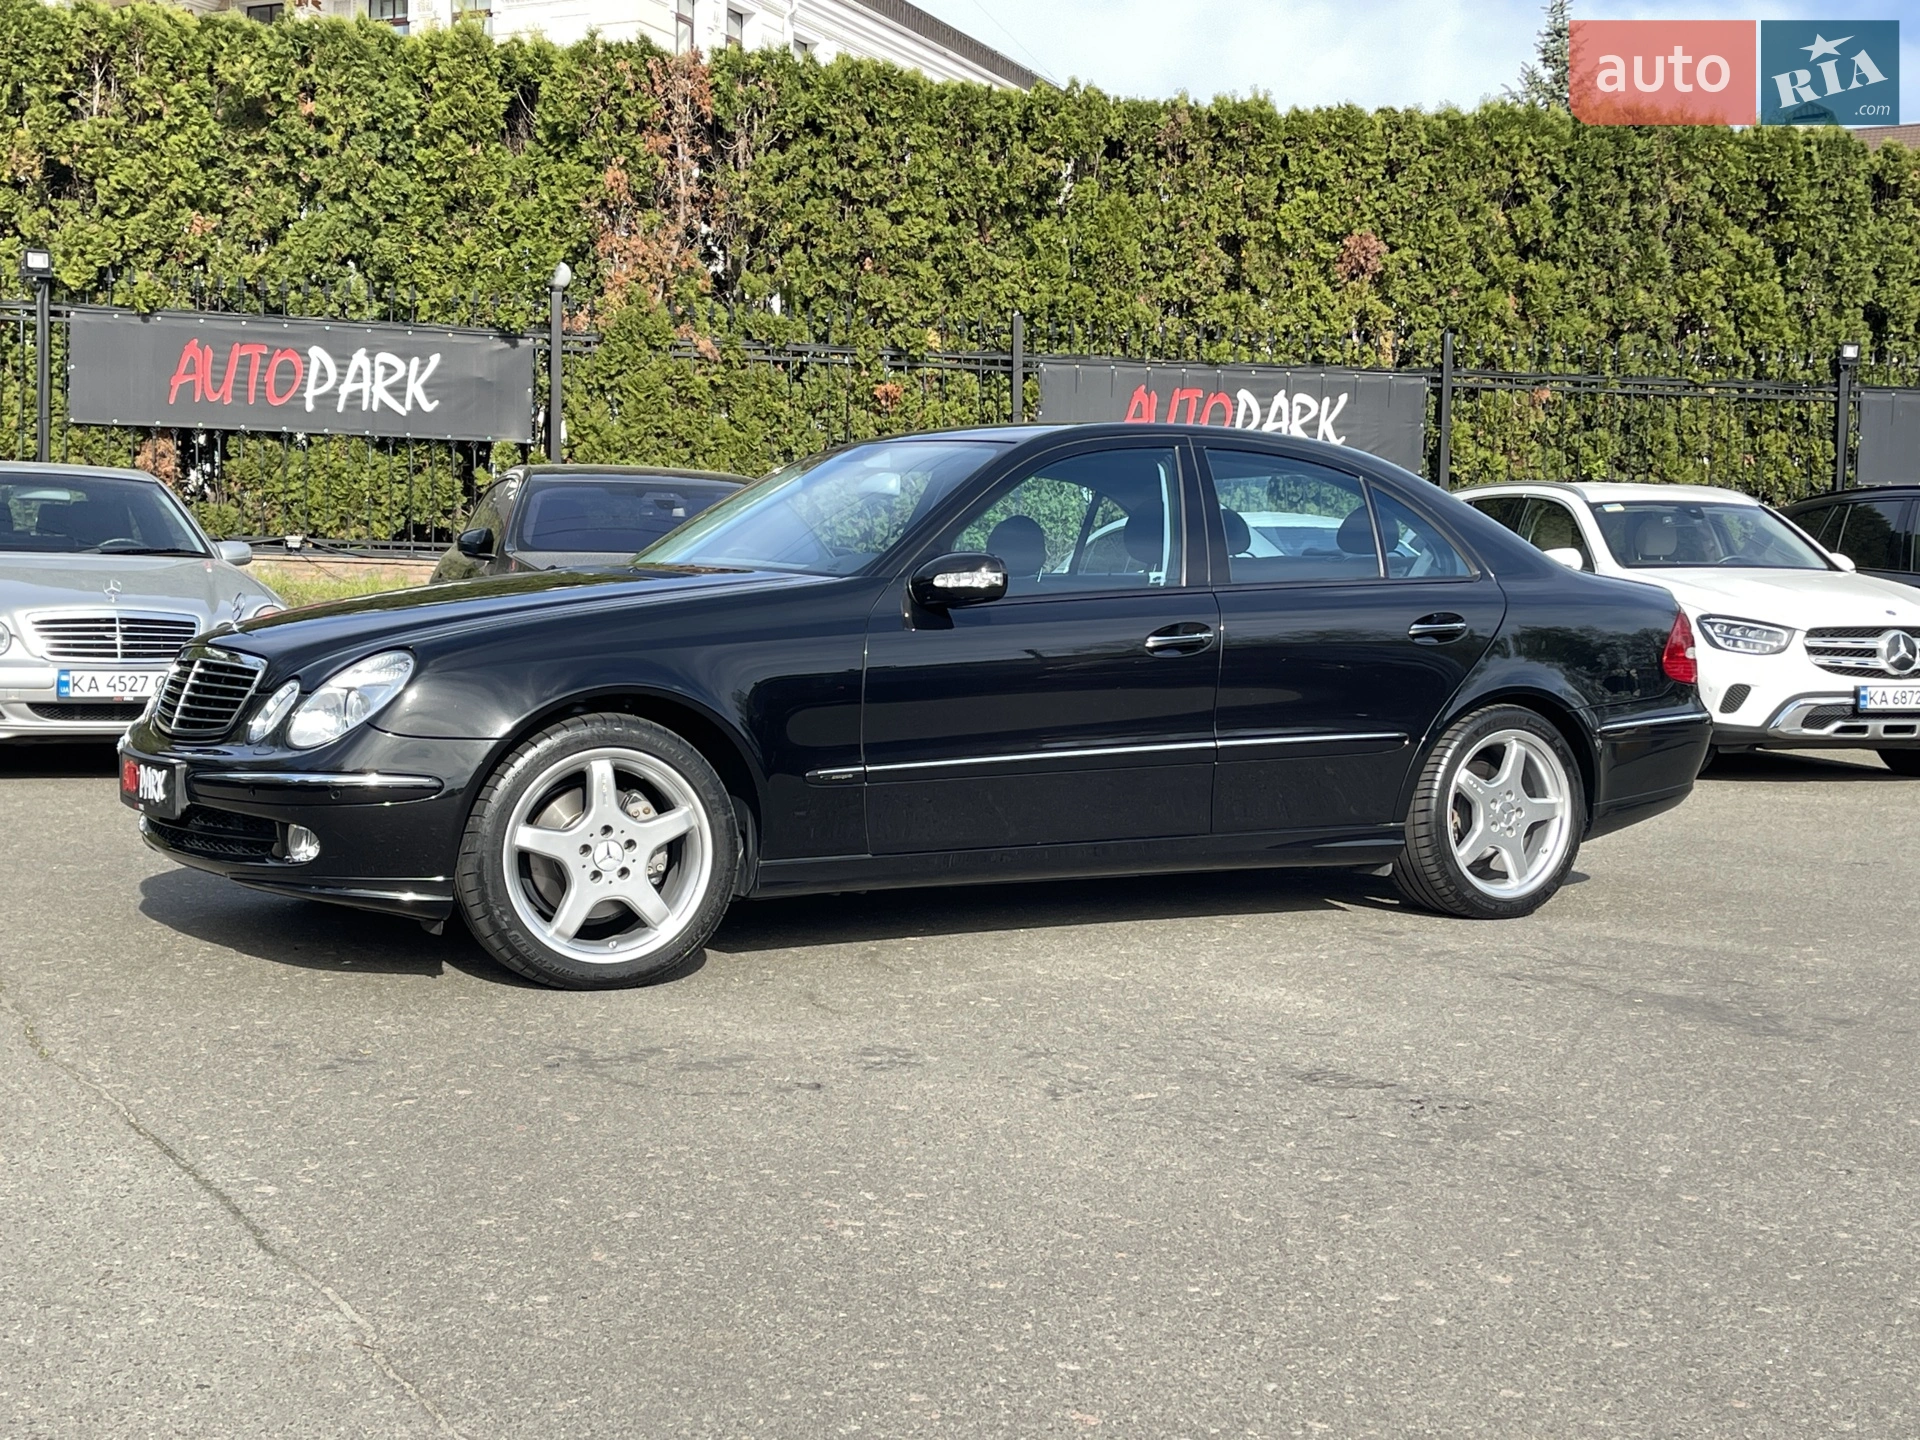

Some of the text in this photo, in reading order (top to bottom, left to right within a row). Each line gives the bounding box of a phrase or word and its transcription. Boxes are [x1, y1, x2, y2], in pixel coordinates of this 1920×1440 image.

[168, 338, 441, 416] AUTOPARK
[71, 675, 100, 693] KA
[106, 675, 149, 693] 4527
[1869, 690, 1920, 706] KA 6872
